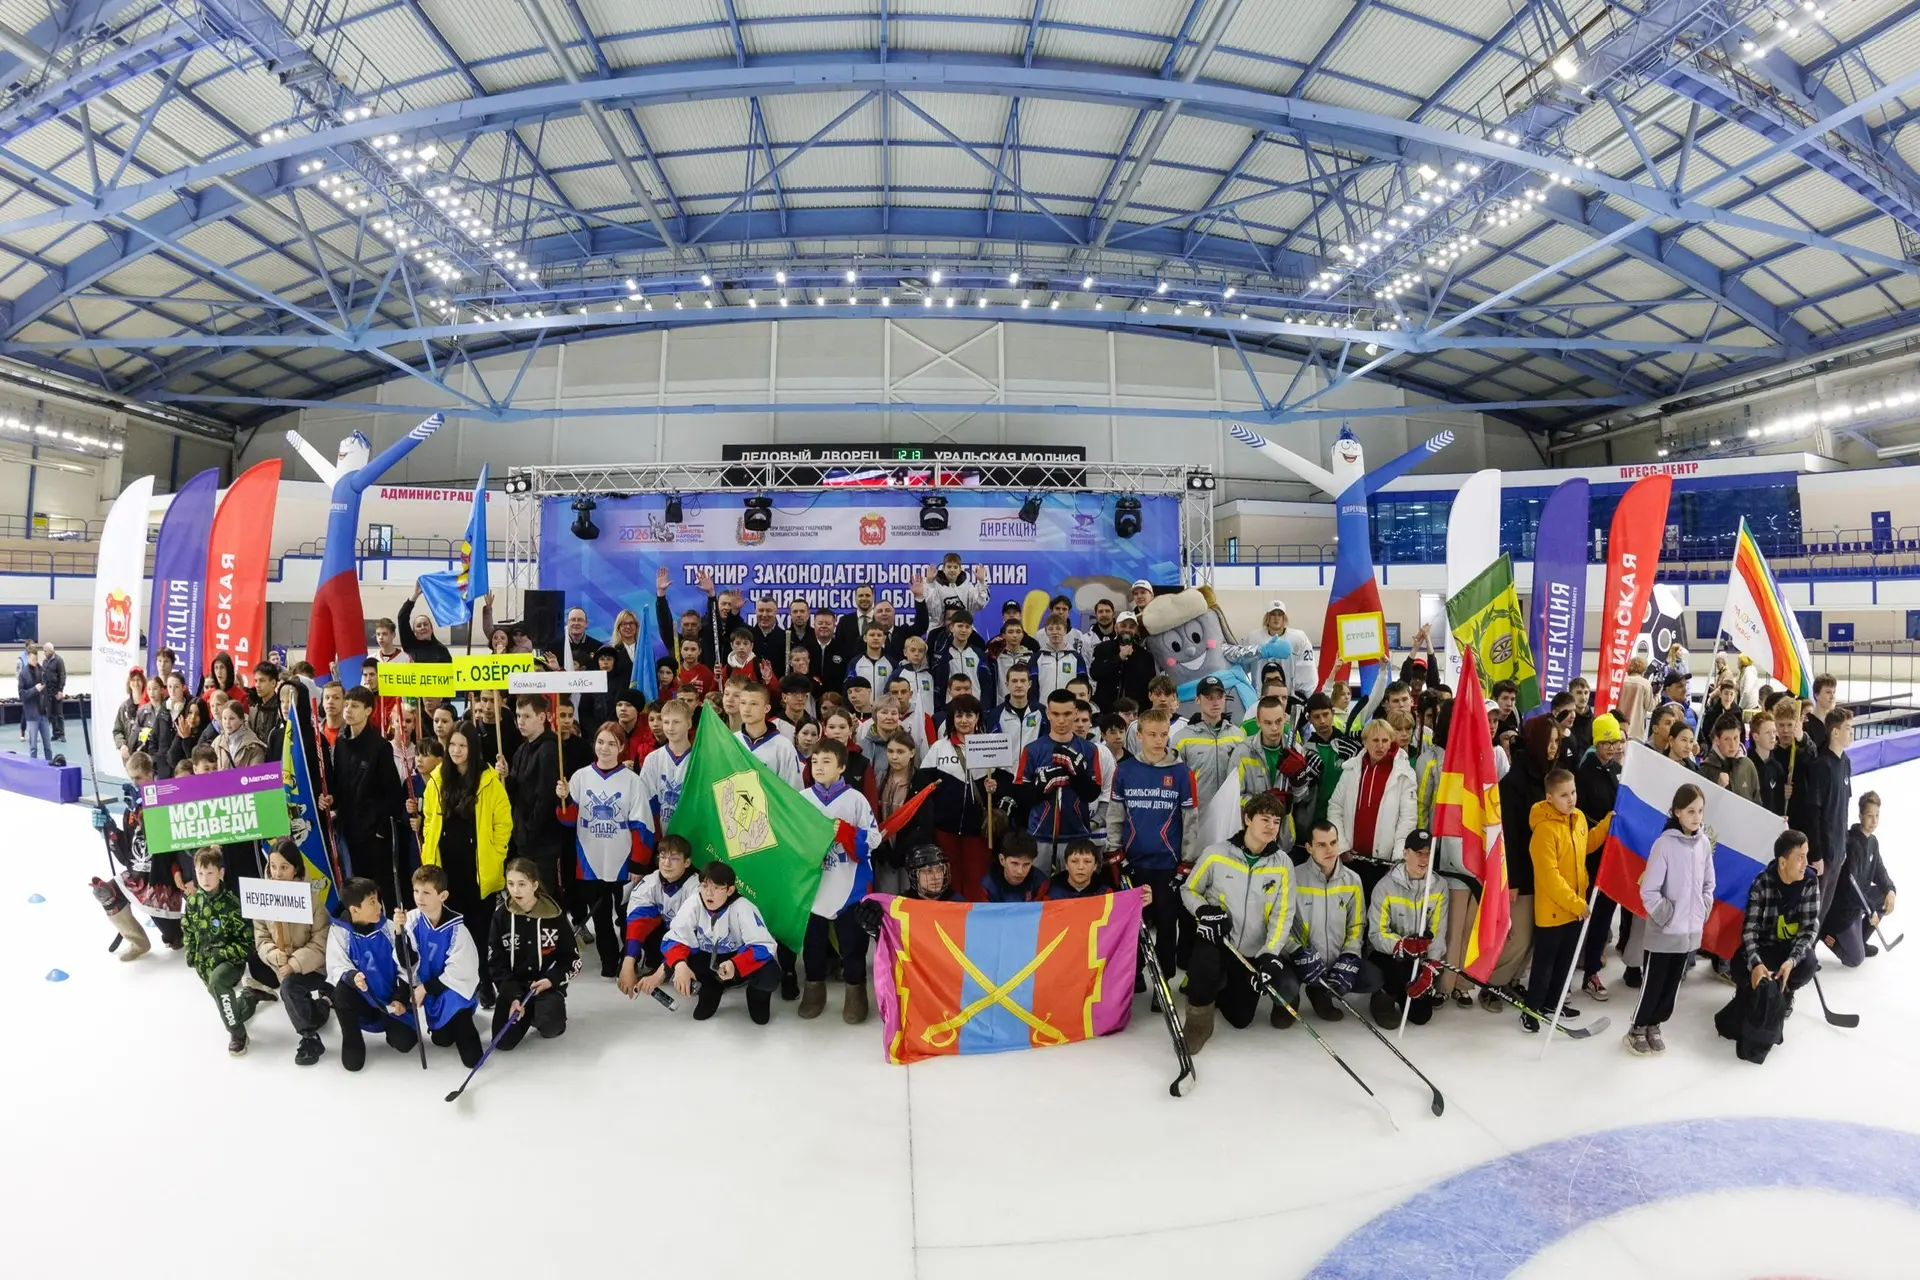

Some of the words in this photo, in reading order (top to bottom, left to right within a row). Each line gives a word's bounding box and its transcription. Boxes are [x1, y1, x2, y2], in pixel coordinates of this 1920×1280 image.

[741, 448, 812, 460] ЛЕДОВЫЙ
[821, 450, 880, 460] ДВОРЕЦ
[934, 451, 1017, 462] УРАЛЬСКАЯ
[1020, 452, 1080, 462] МОЛНИЯ
[1620, 463, 1698, 478] ПРЕСС-ЦЕНТР
[380, 488, 490, 503] АДМИНИСТРАЦЯ
[619, 528, 649, 540] 2026
[979, 522, 1037, 538] ДИРЕКЦИЯ
[684, 564, 748, 584] ТУРНИР
[216, 553, 236, 650] НСКАЯ
[1346, 632, 1375, 641] СТРЕЛА
[1672, 630, 1676, 639] 6
[396, 673, 417, 685] ЕЩЁ
[456, 670, 466, 682] г.
[513, 681, 546, 689] Команда
[1161, 790, 1179, 798] ЦЕНТР
[168, 793, 256, 823] МОГУЧИЕ
[1153, 800, 1173, 809] ДЕТЯМ
[170, 811, 258, 840] МЕДВЕДИ
[246, 892, 306, 910] НЕУДЕРЖИМЫЕ
[428, 942, 438, 962] 7
[364, 950, 377, 971] 2
[220, 994, 236, 1026] Kappa
